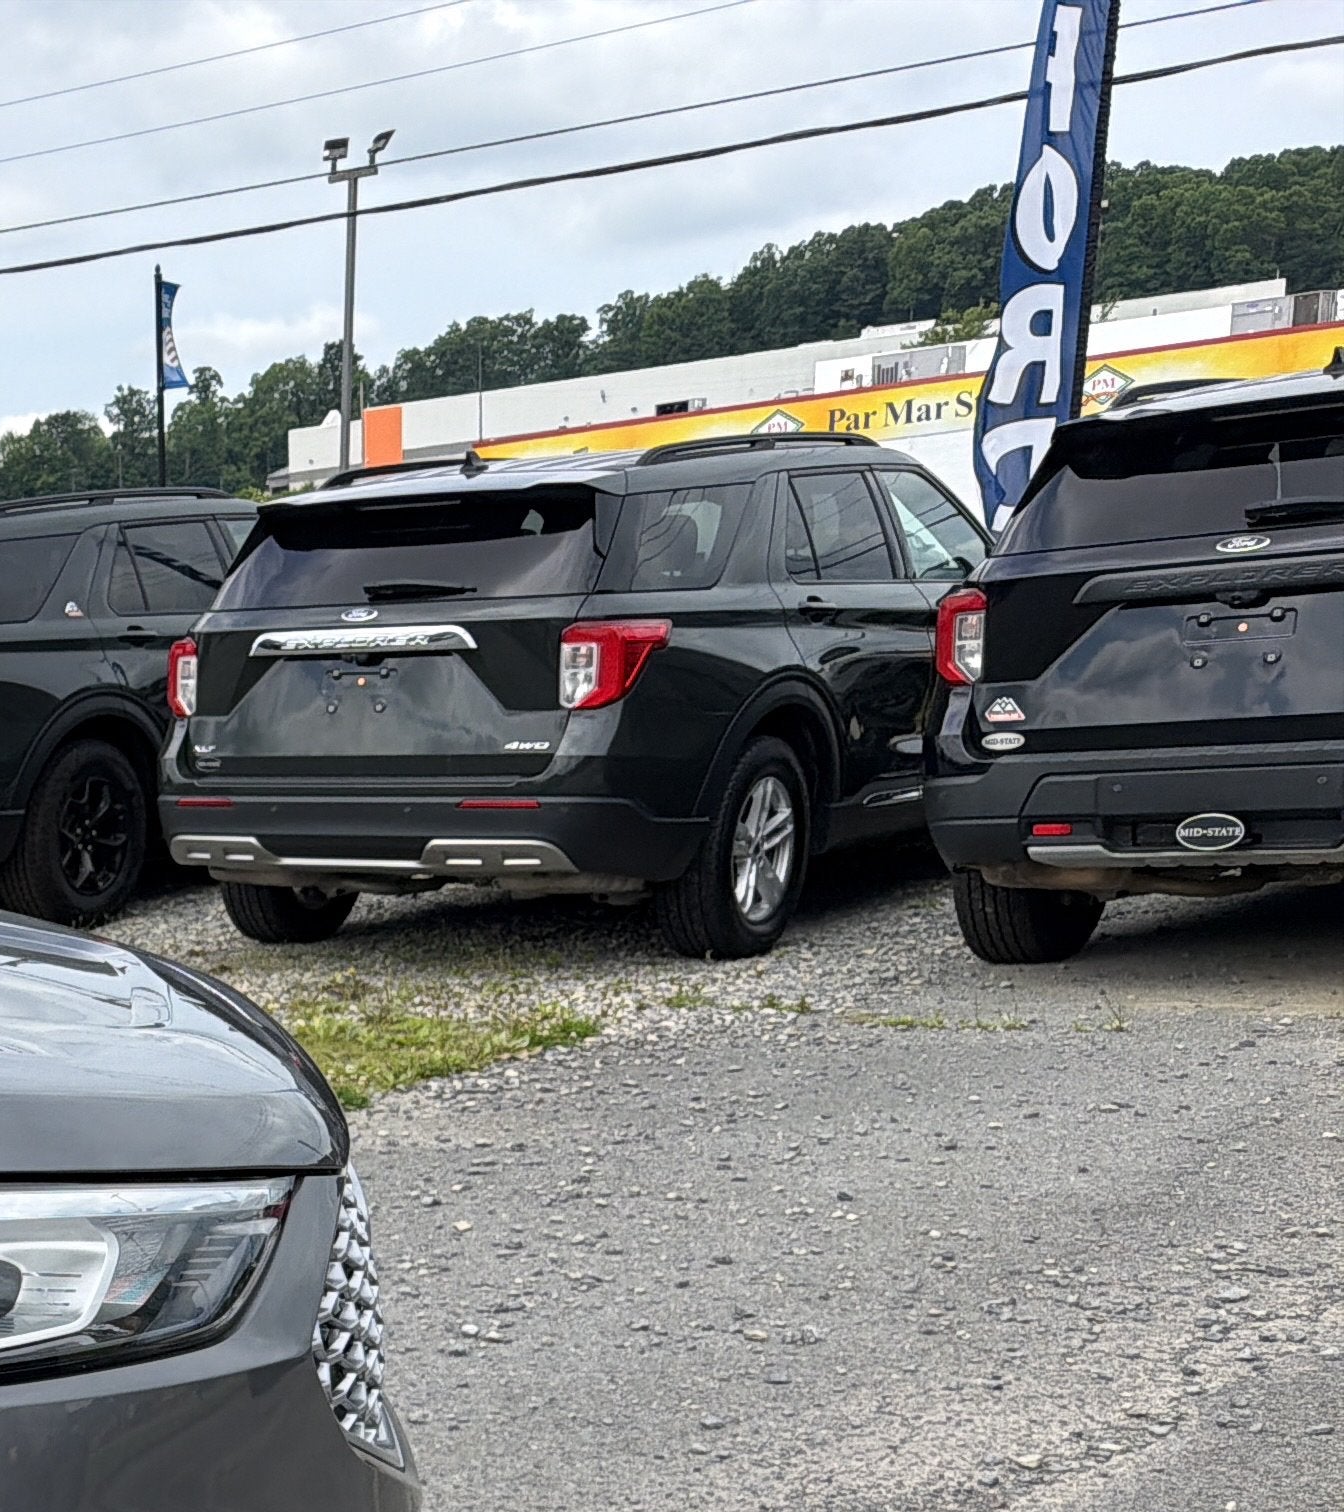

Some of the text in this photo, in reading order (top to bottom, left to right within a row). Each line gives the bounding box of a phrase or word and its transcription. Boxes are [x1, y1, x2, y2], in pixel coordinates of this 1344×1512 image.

[827, 390, 974, 433] Par Mar S
[1226, 536, 1259, 549] Ford
[503, 740, 551, 750] 4WD
[1179, 826, 1243, 838] MID-STATE
